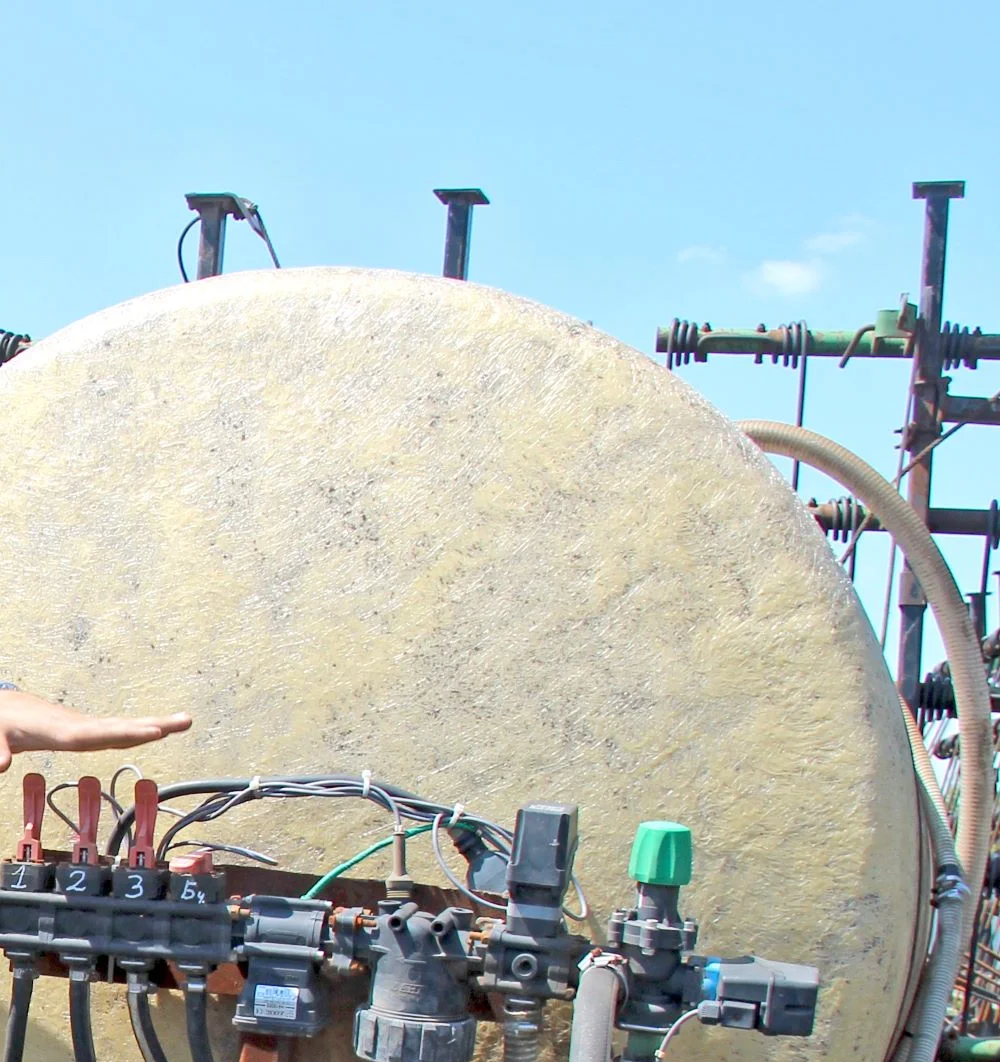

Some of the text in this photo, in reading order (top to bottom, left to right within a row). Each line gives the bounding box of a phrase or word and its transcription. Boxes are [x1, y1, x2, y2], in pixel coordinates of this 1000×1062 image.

[10, 865, 27, 889] 1
[65, 870, 87, 892] 2
[124, 874, 144, 899] 3
